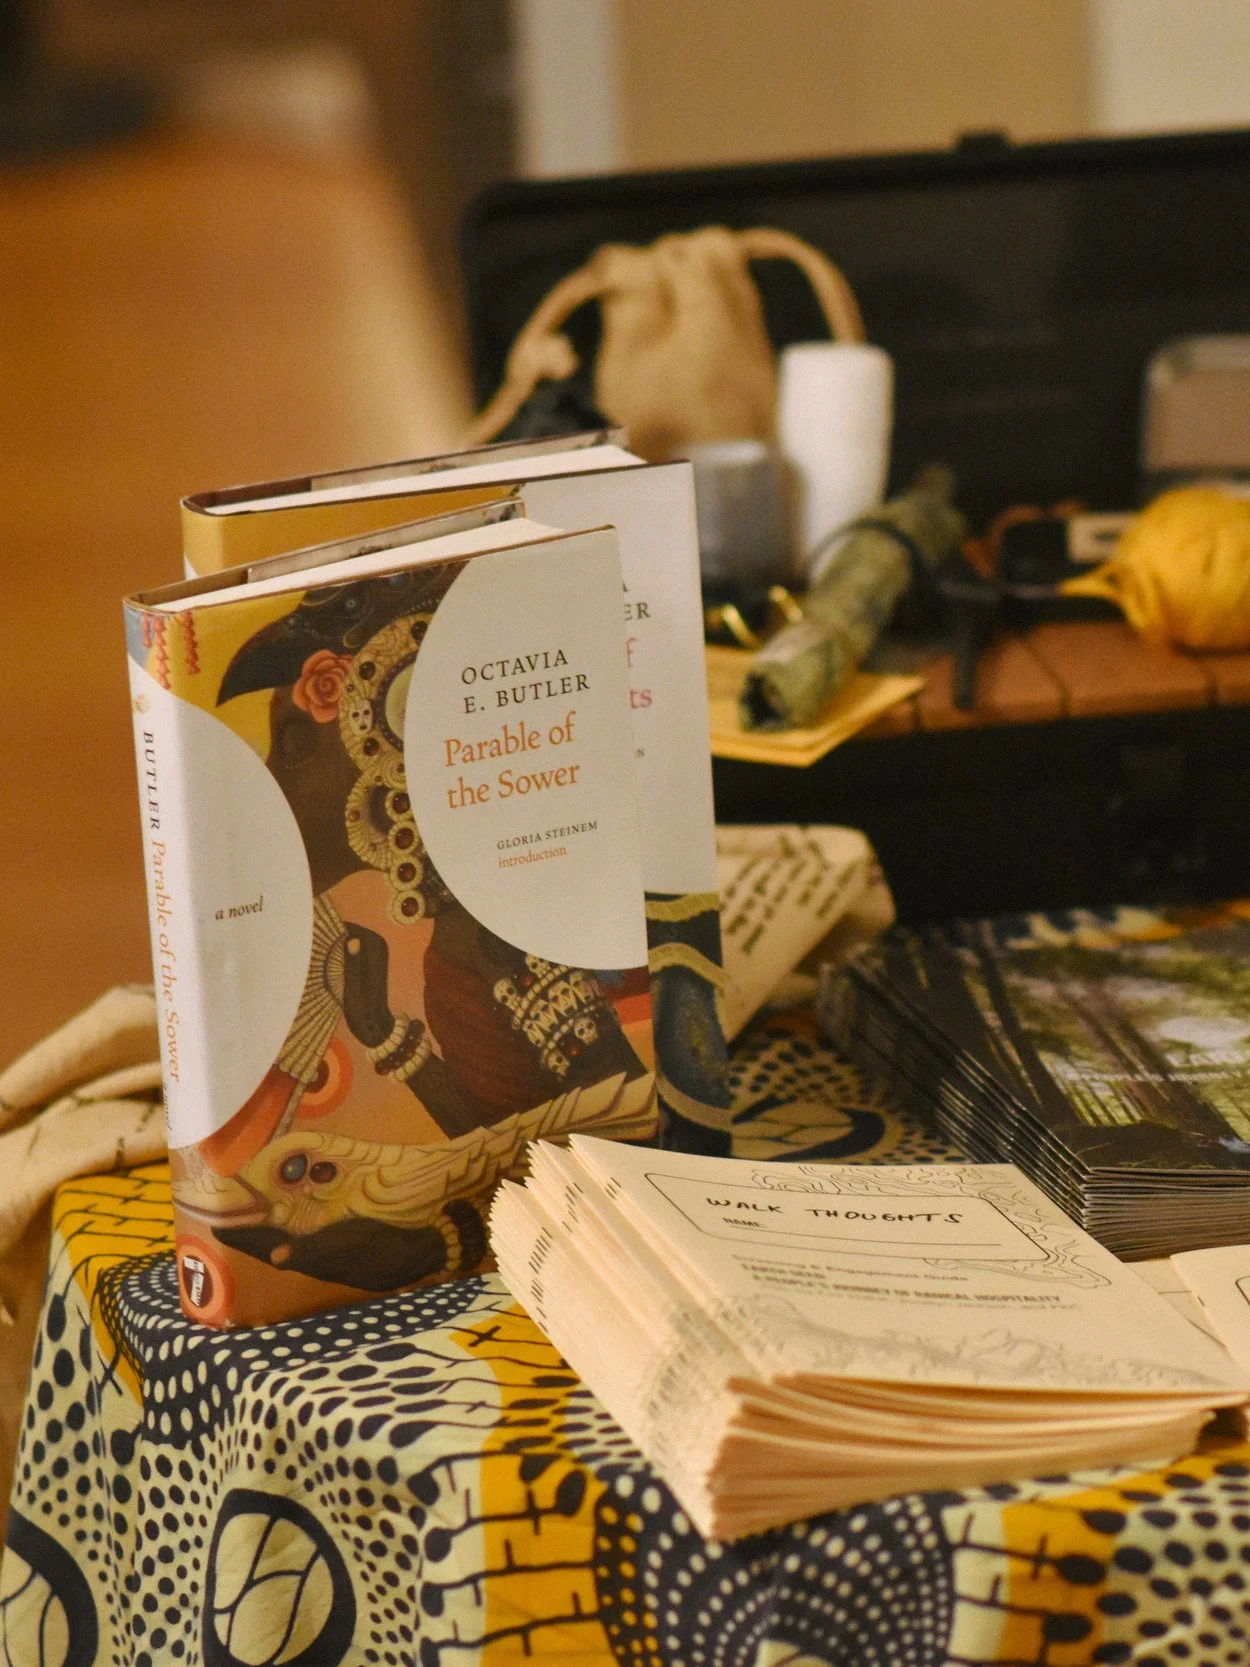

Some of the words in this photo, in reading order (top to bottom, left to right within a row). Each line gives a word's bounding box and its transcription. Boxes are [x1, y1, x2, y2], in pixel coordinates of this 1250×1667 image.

[461, 649, 569, 685] OCTAVIA
[463, 696, 485, 714] E.
[496, 674, 590, 708] BUTLER
[444, 720, 541, 767] Parable
[548, 710, 576, 746] of
[143, 731, 160, 830] BUTLER
[447, 776, 490, 809] the
[498, 764, 580, 798] Sower
[497, 832, 543, 850] GLORIA
[545, 820, 598, 840] STEINEM
[499, 846, 567, 869] introduction
[151, 838, 173, 926] Parable
[215, 909, 224, 920] a
[229, 895, 264, 918] novel
[159, 933, 176, 962] of
[161, 964, 177, 1001] the
[165, 1009, 180, 1083] Sower
[706, 1197, 784, 1213] WALK
[805, 1207, 964, 1224] THOUGHTS
